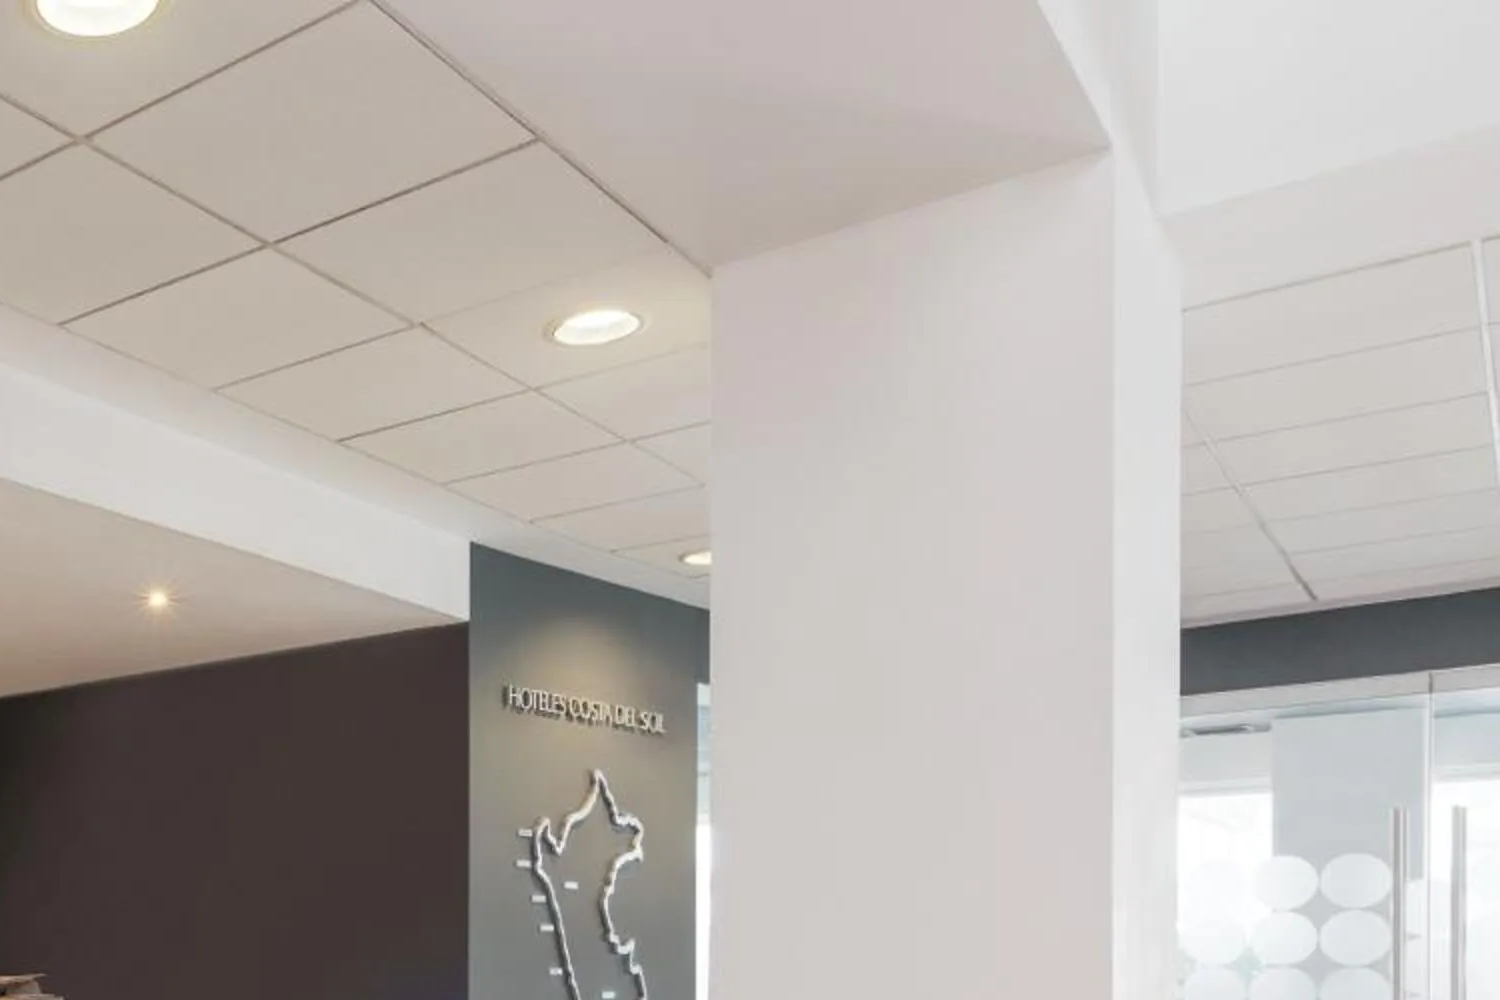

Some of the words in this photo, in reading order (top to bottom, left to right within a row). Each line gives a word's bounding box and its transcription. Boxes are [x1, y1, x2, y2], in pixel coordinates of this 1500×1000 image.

[507, 683, 566, 714] HOTELES
[569, 696, 612, 727] COSTA
[614, 704, 637, 728] DEL
[639, 711, 667, 734] SOL
